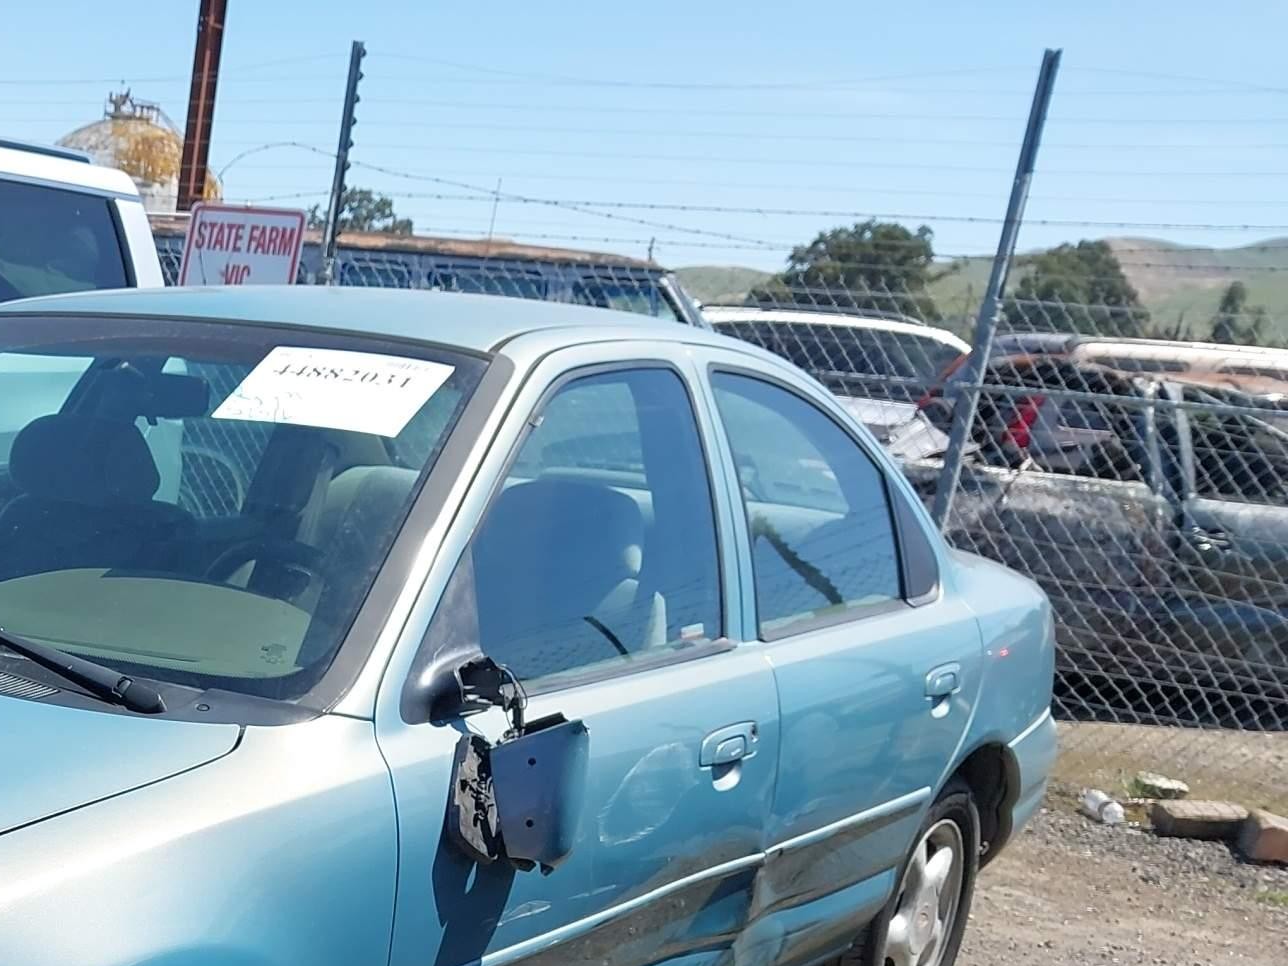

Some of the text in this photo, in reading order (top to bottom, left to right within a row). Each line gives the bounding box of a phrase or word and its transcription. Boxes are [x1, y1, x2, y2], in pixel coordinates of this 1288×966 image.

[195, 221, 296, 257] STATE FARM
[274, 364, 411, 388] 44882031
